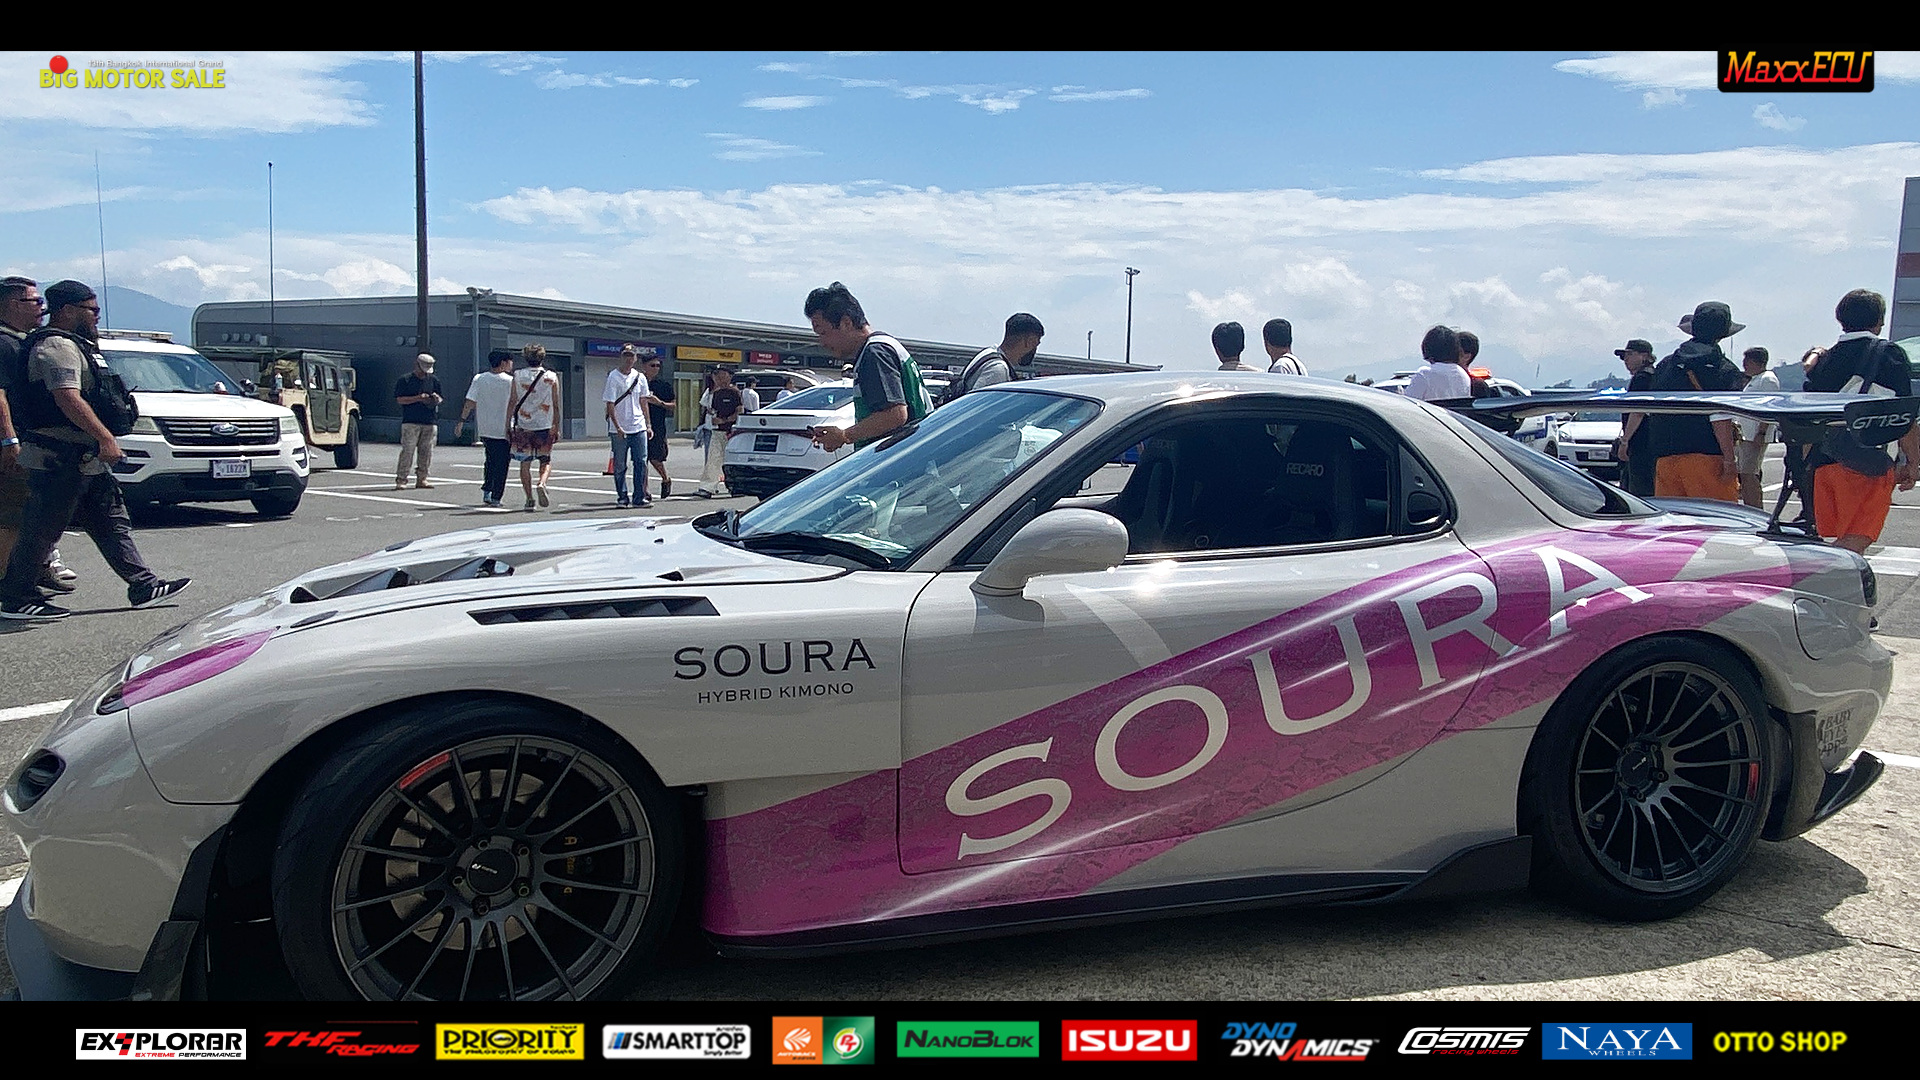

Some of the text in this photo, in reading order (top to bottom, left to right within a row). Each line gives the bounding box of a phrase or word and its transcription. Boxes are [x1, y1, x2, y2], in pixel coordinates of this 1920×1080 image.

[1286, 462, 1324, 477] RECARO
[673, 638, 877, 680] SOURA
[698, 682, 854, 704] HYBRID KIMONO
[945, 544, 1654, 861] SOURA
